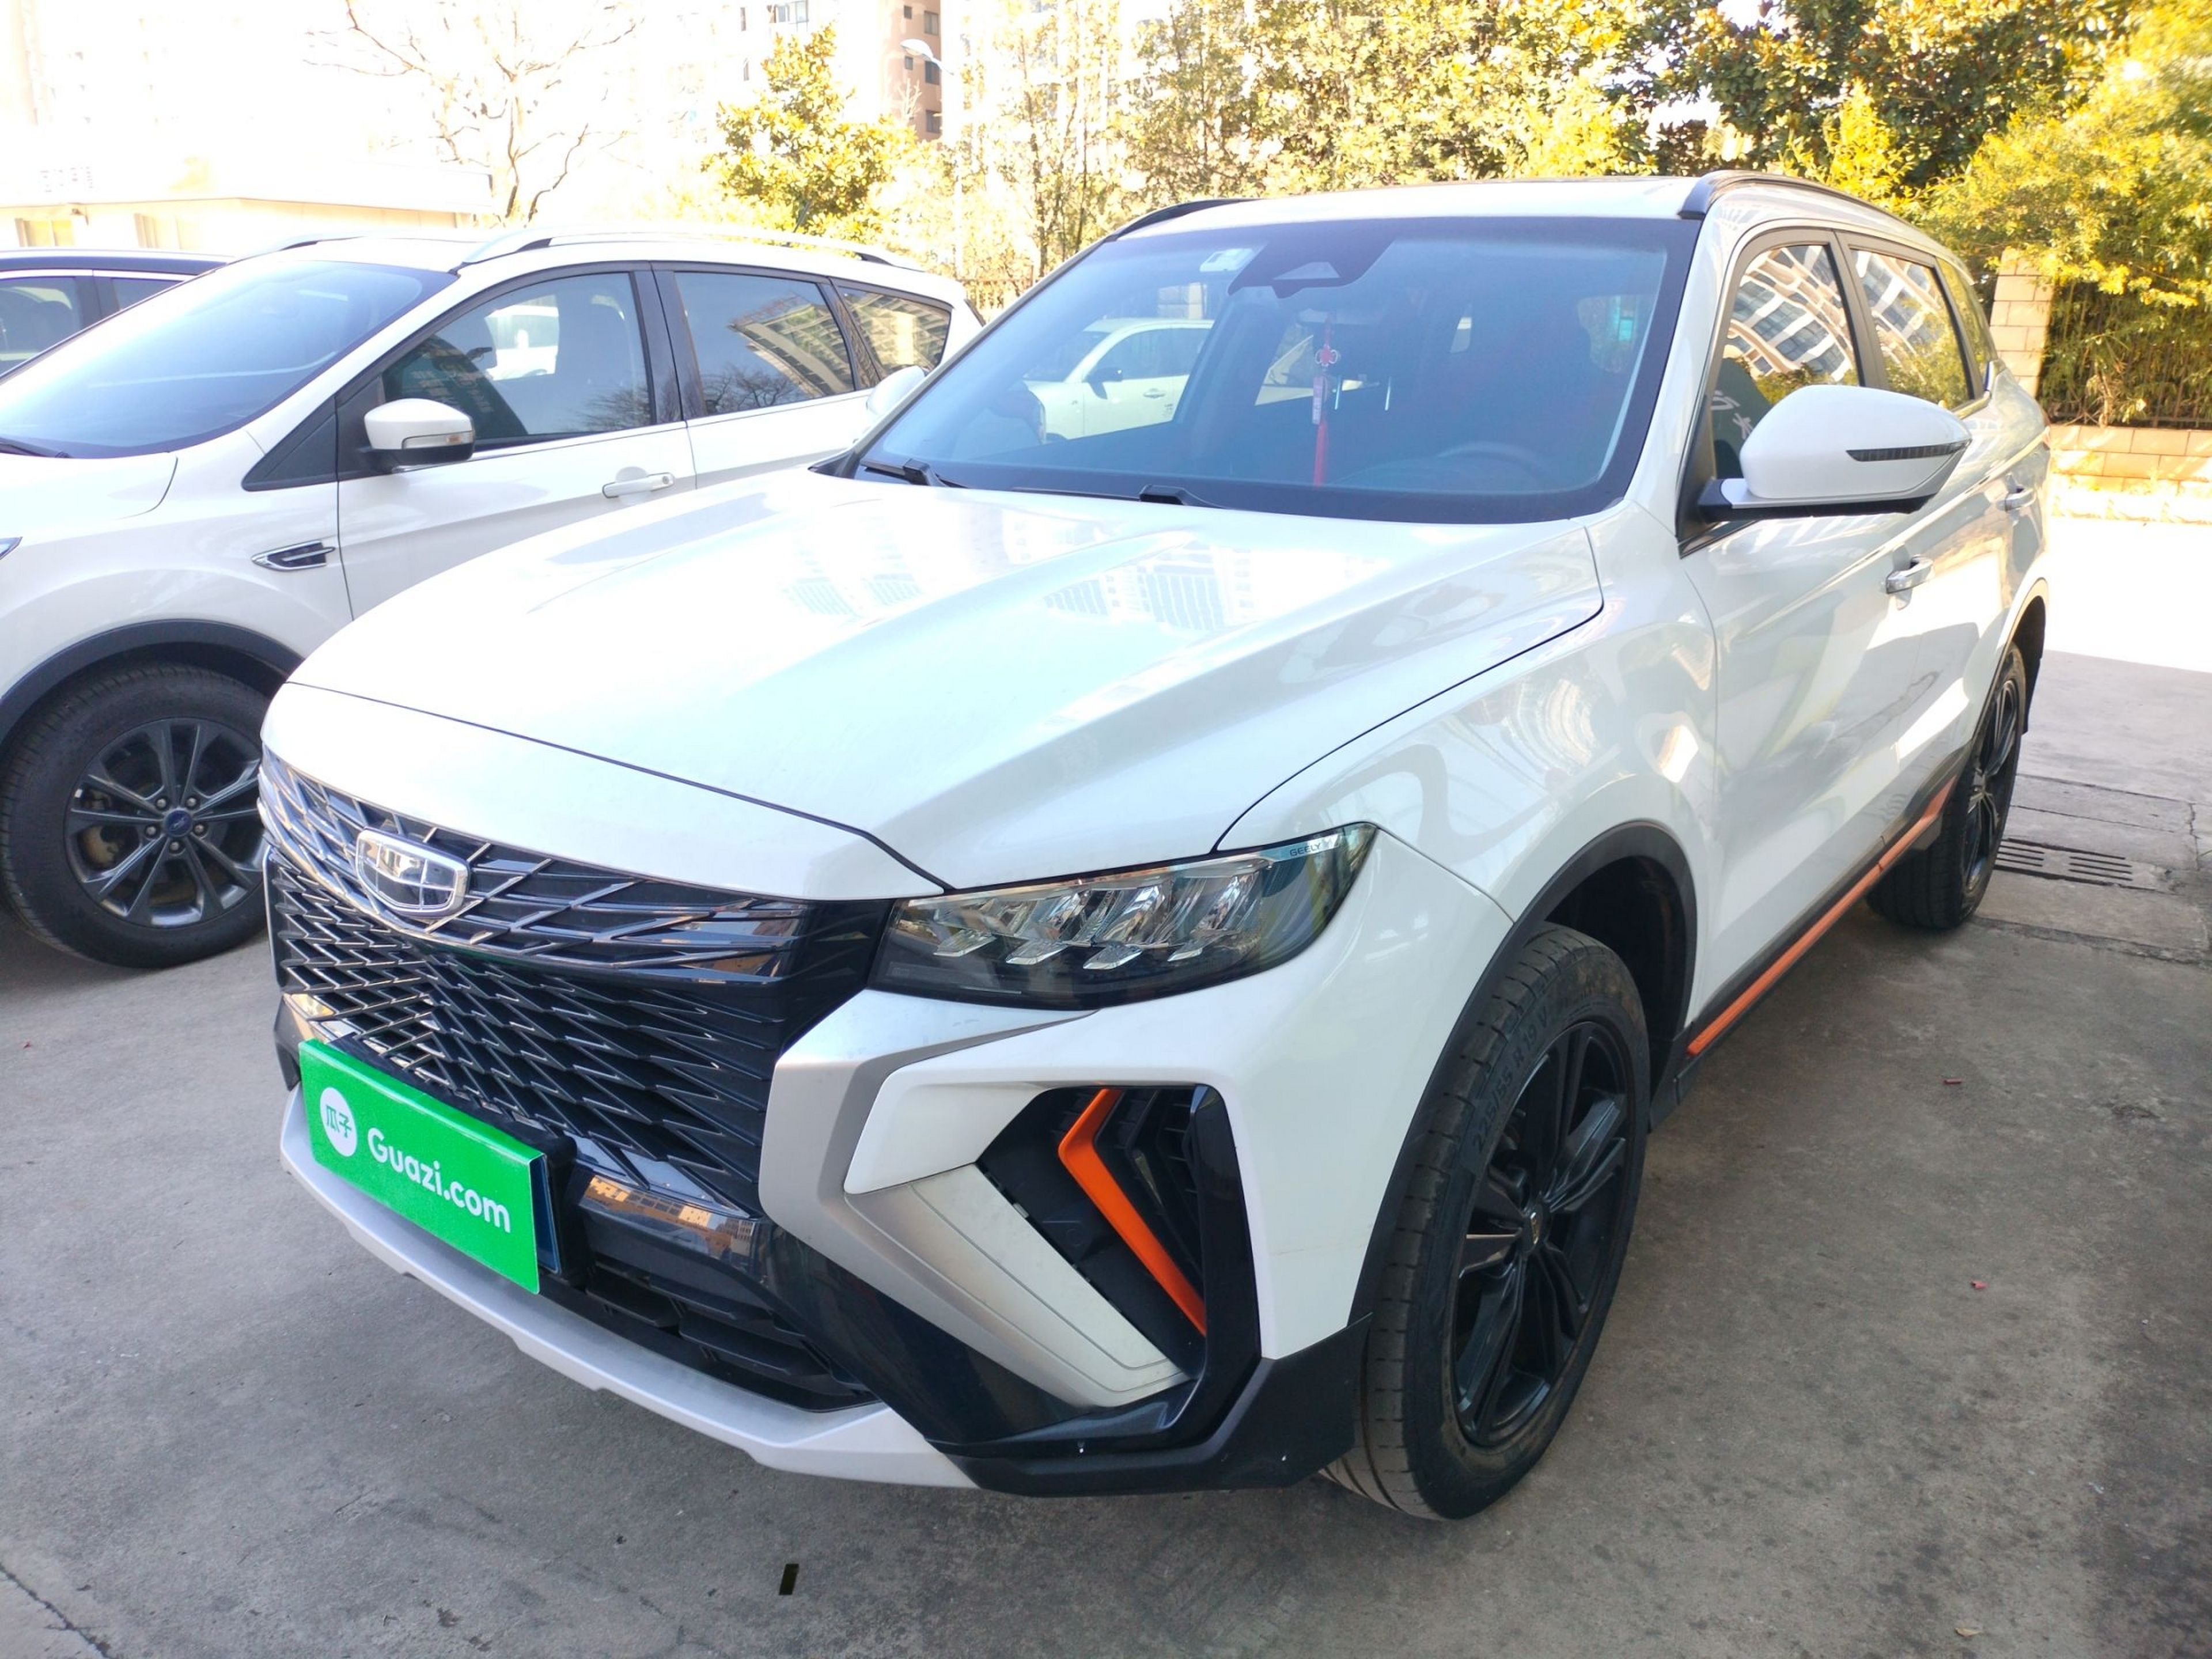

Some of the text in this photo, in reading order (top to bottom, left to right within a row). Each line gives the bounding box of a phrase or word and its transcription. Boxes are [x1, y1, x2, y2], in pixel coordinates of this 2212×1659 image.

[1290, 843, 1321, 857] GEELY
[326, 1105, 352, 1138] 瓜子
[368, 1127, 510, 1233] Guazi.com
